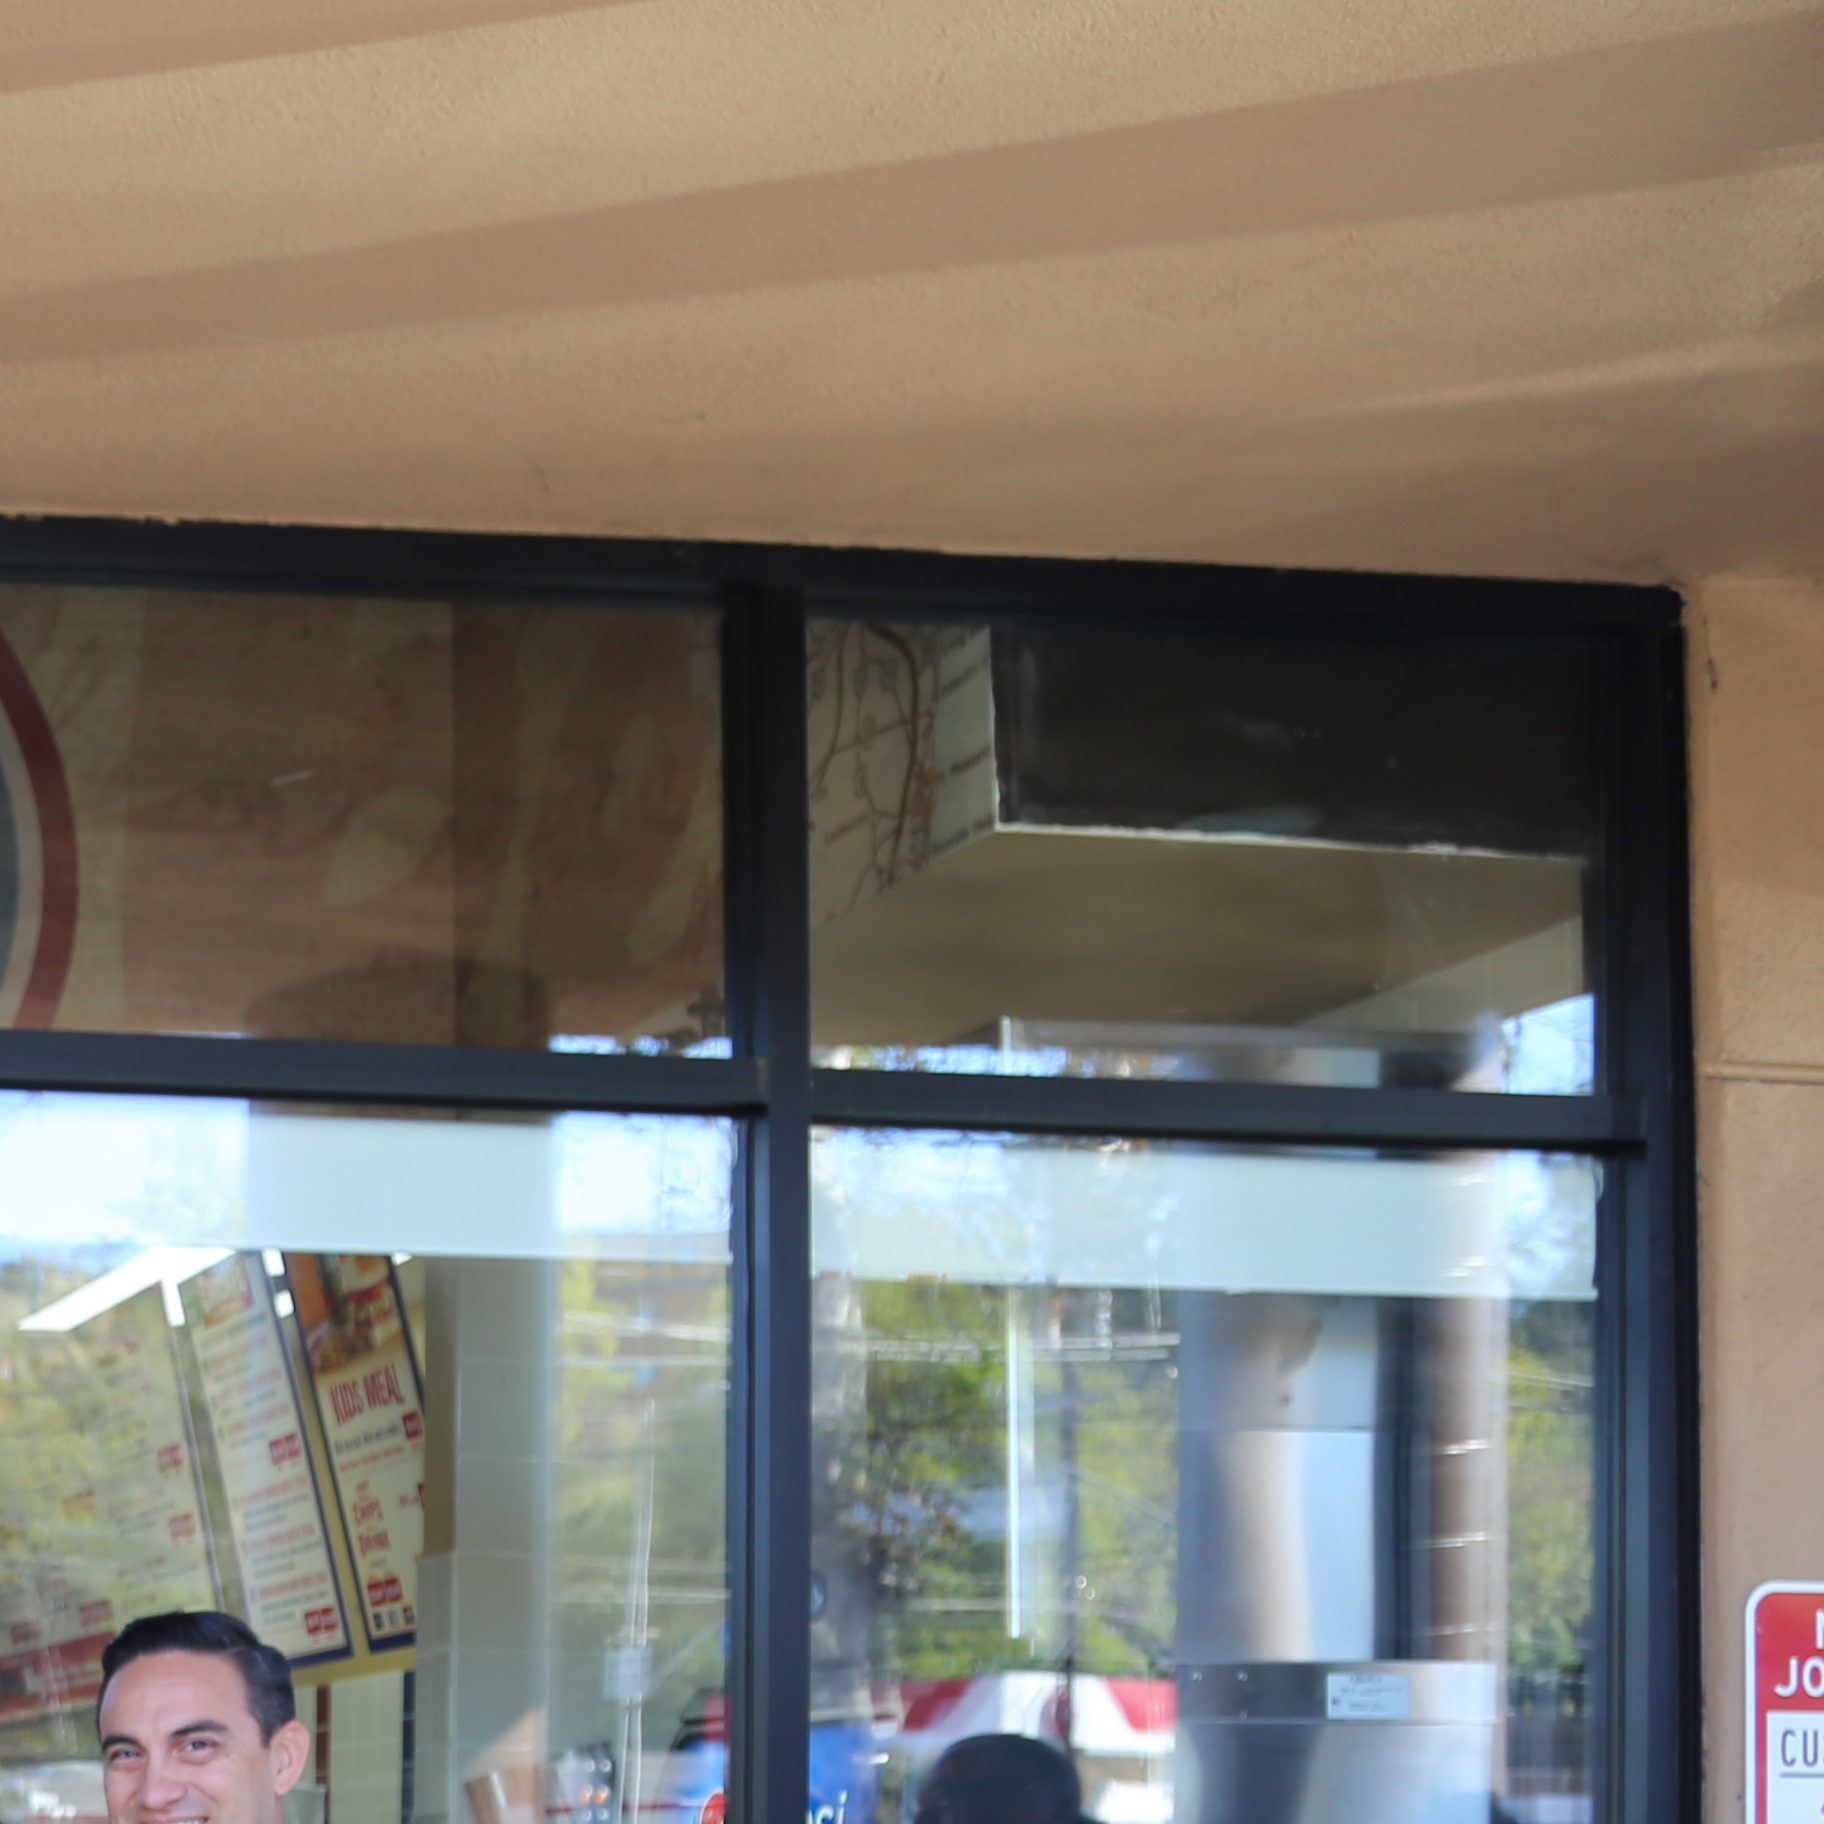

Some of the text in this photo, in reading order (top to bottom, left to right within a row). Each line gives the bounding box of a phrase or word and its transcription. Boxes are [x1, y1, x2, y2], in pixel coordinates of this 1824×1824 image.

[330, 1361, 406, 1426] KIDS MEAL
[1780, 1729, 1824, 1767] CU
